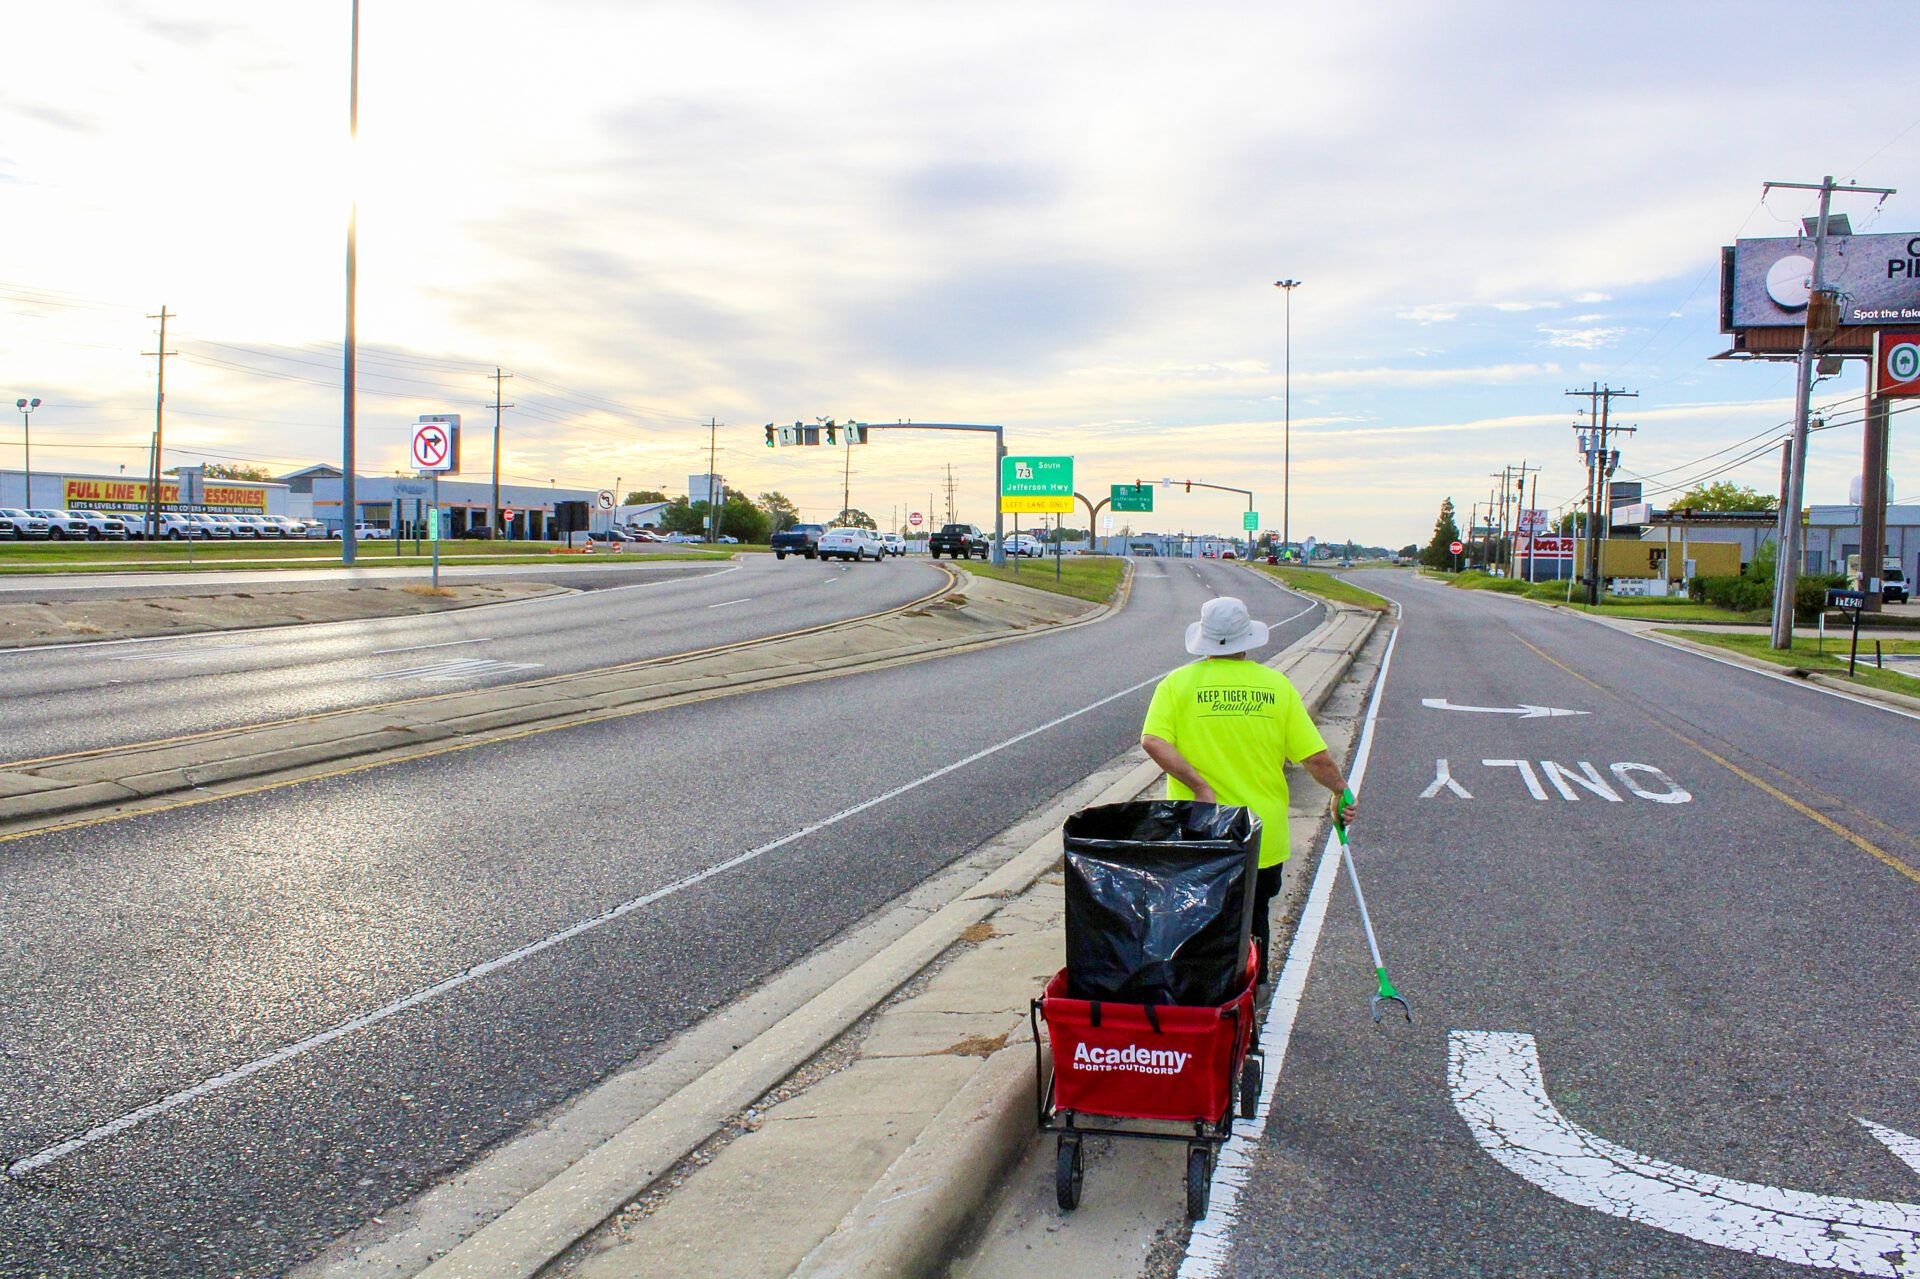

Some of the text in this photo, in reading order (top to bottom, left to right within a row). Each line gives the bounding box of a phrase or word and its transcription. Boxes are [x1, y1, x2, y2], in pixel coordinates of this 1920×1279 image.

[1853, 309, 1878, 321] Spot
[1881, 308, 1899, 319] the
[1017, 468, 1031, 478] 73
[67, 481, 100, 499] FULL
[105, 482, 135, 500] LINE
[1006, 483, 1069, 492] Jefferson Hwy
[70, 501, 87, 509] LIFTS
[94, 502, 116, 510] LEVELS
[1197, 690, 1275, 704] KEEP TIGER TOWN
[1212, 701, 1263, 715] Beautiful
[1419, 759, 1692, 803] ONLY
[1074, 1042, 1188, 1073] Academy
[1073, 1062, 1174, 1075] SPORTS+OUTDOORS
